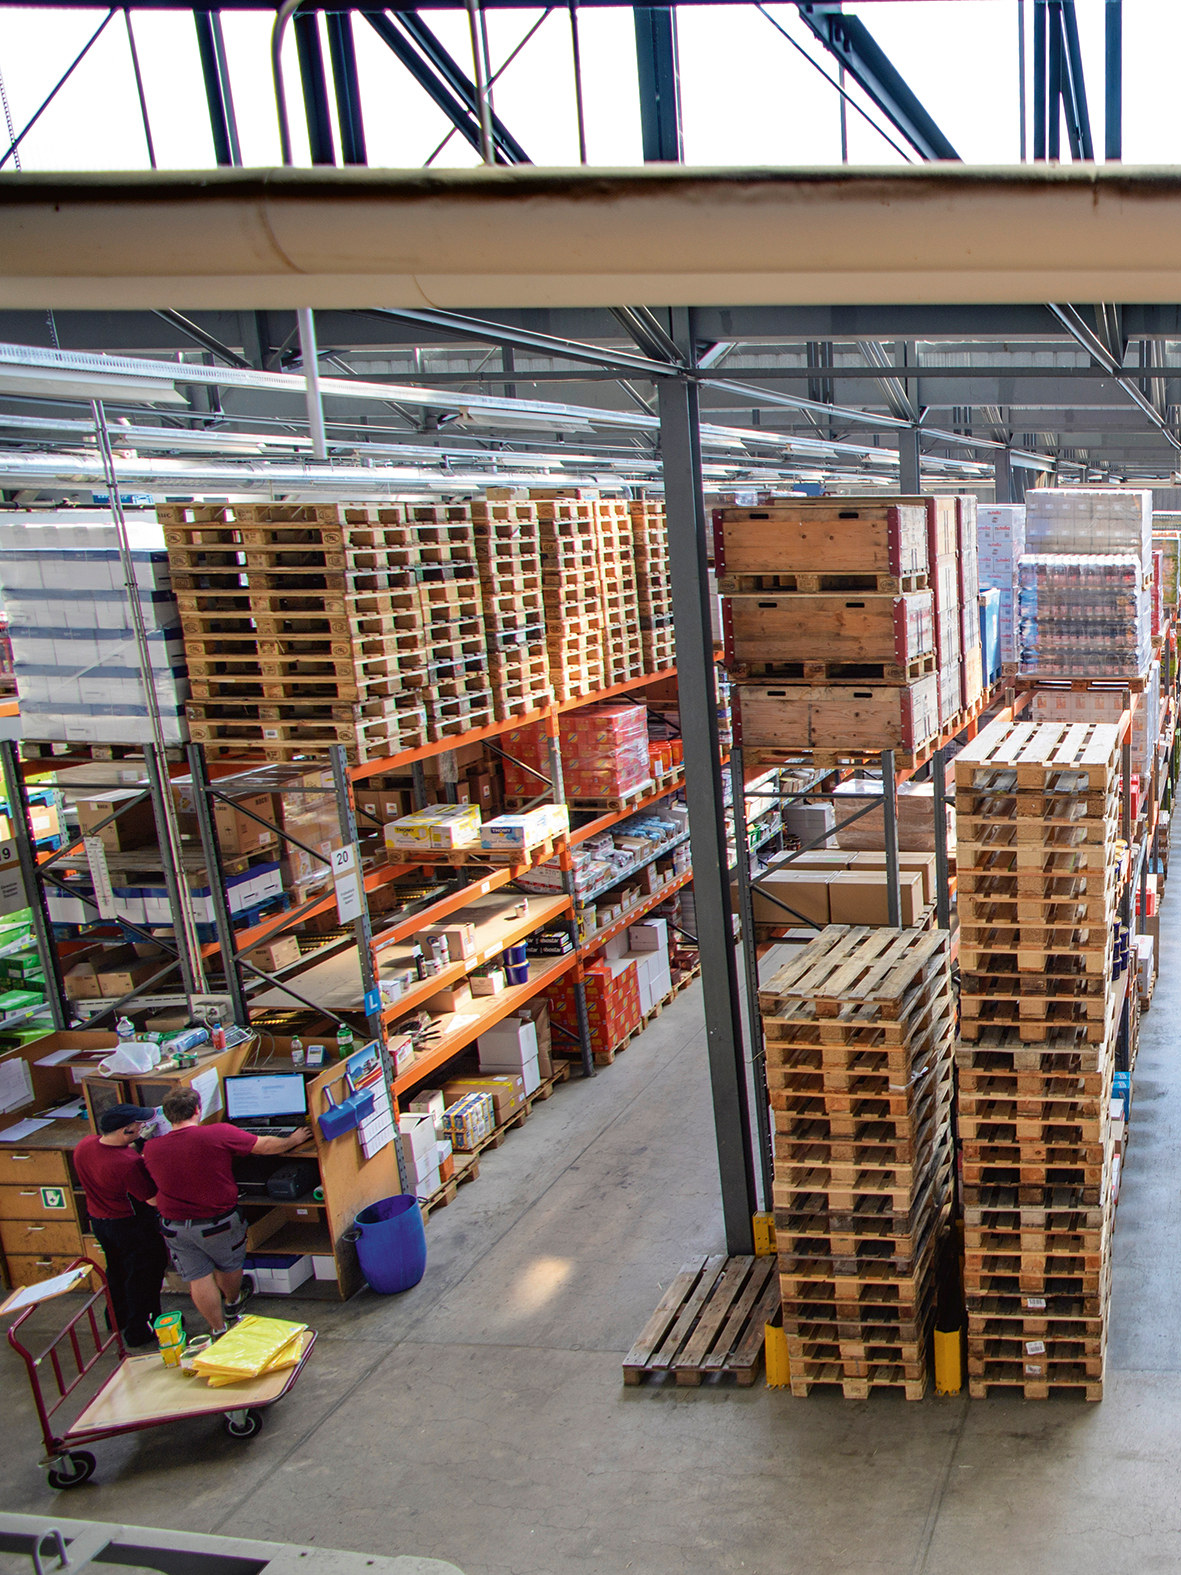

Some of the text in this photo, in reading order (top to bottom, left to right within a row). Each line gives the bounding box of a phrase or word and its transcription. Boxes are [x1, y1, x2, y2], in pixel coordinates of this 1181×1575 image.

[0, 847, 11, 860] 9
[336, 850, 349, 866] 20
[369, 994, 379, 1010] L
